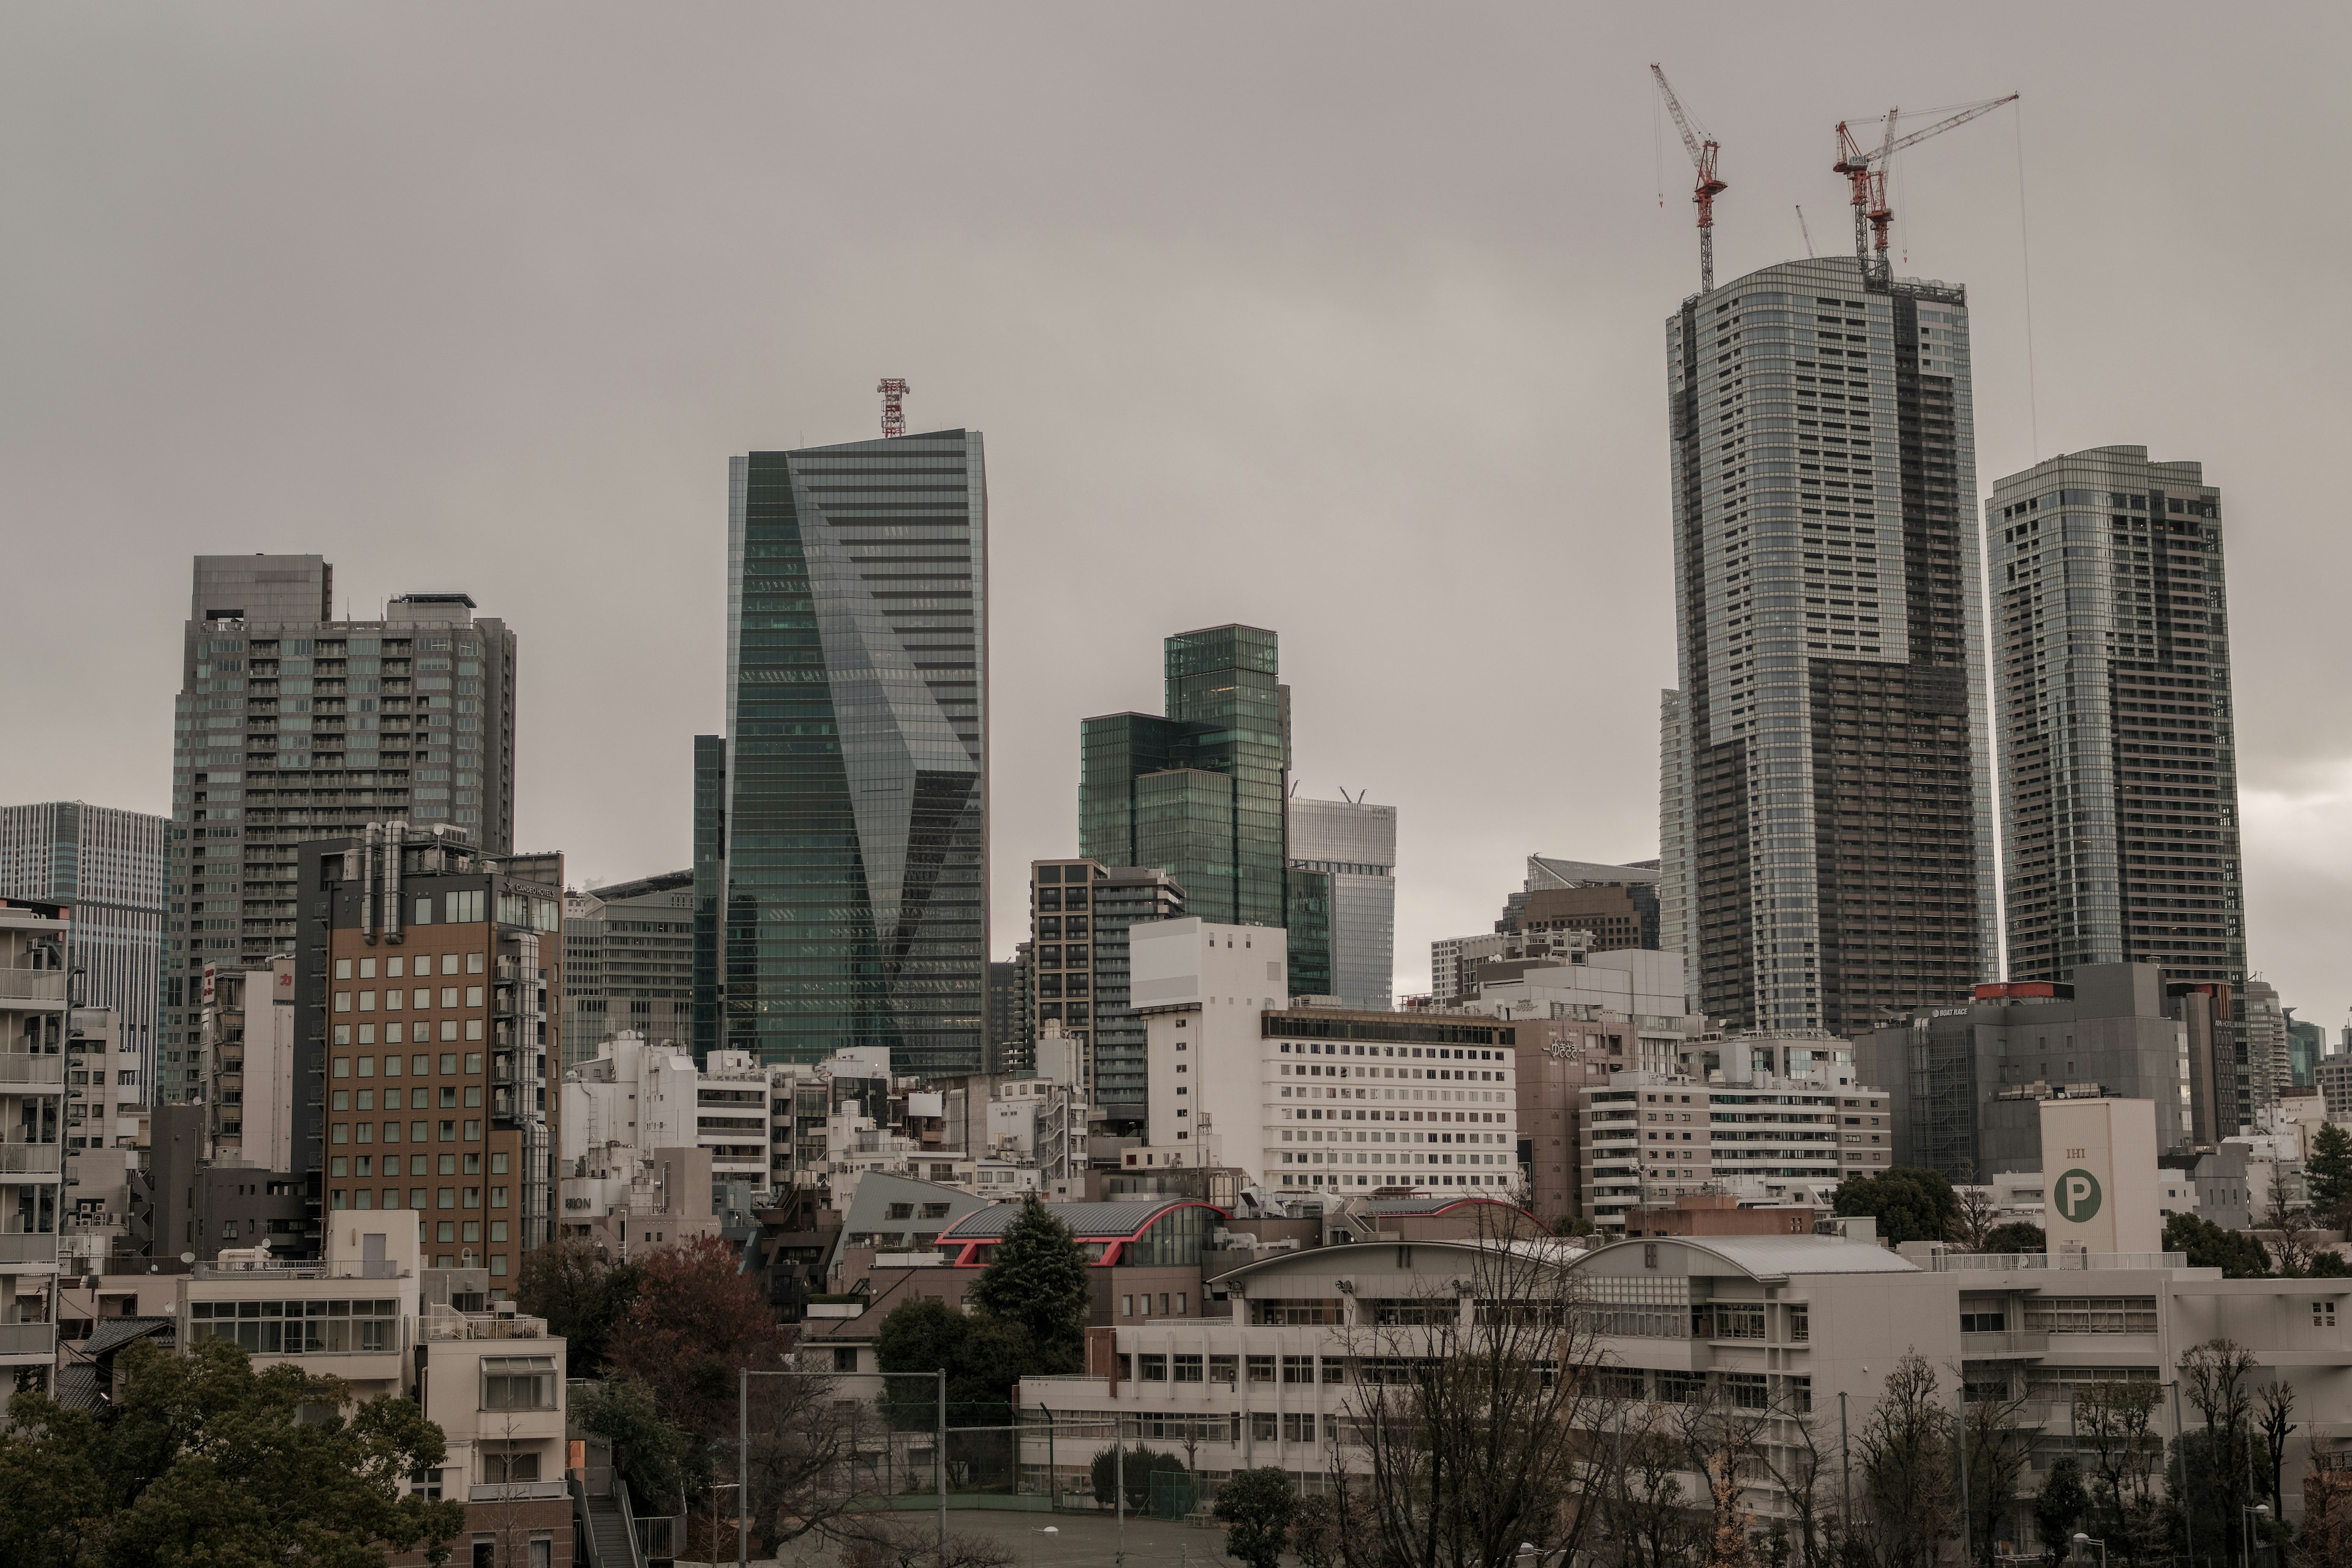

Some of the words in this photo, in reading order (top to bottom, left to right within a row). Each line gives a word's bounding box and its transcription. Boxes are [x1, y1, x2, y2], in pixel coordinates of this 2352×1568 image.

[516, 884, 536, 894] CANDEO
[537, 888, 554, 897] HOTELS
[2066, 1148, 2086, 1159] IHI
[2066, 1177, 2092, 1216] P
